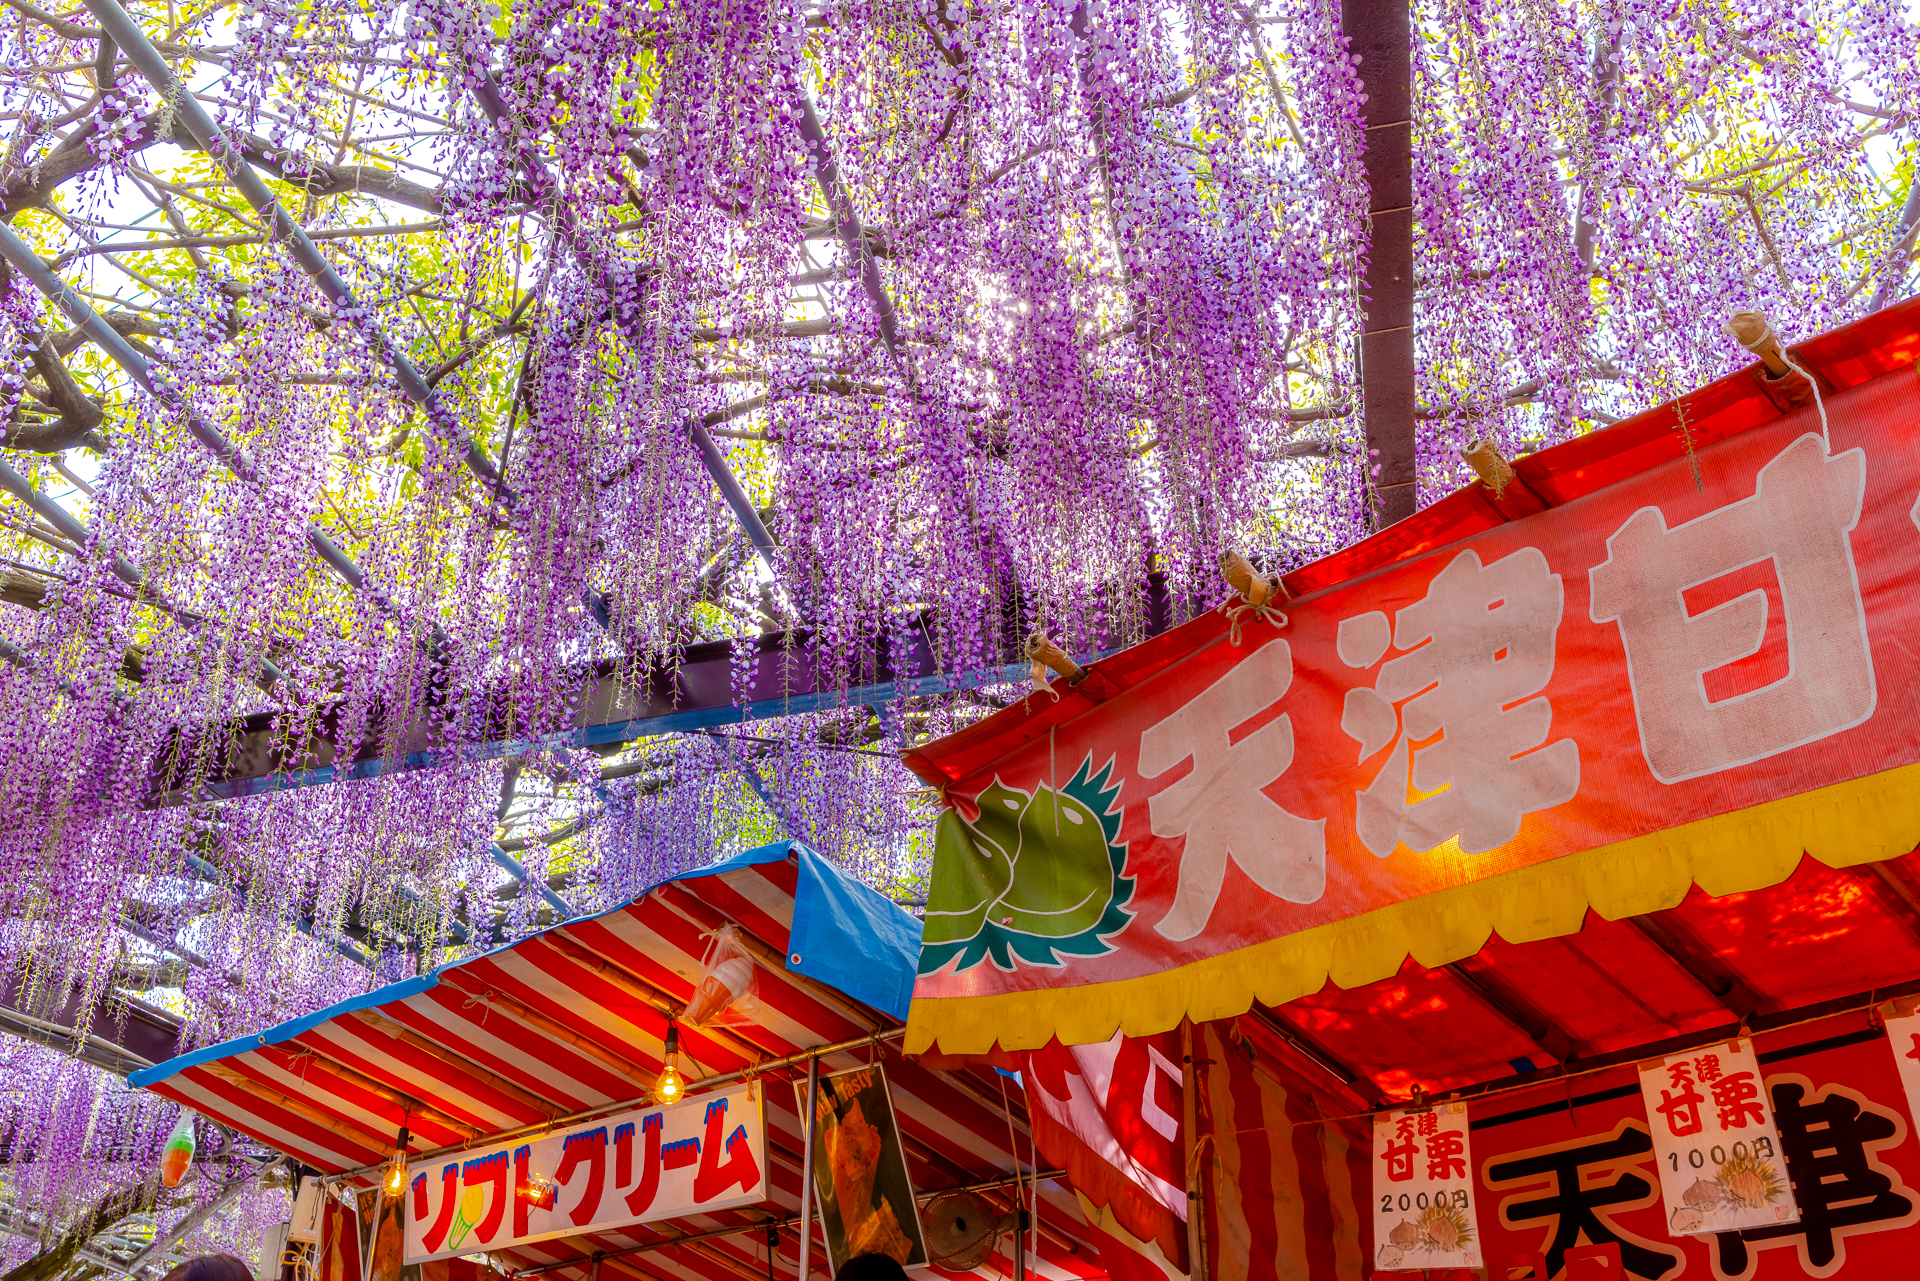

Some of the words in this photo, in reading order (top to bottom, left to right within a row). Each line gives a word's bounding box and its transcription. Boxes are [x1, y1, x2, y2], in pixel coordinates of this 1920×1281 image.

[1137, 431, 1920, 941] 天津甘
[837, 1069, 873, 1101] Tasty
[1667, 1054, 1723, 1089] 天津
[1655, 1071, 1766, 1138] 甘栗
[1395, 1112, 1439, 1140] 天津
[1380, 1130, 1467, 1182] 甘栗
[1668, 1136, 1774, 1172] 1000円
[411, 1096, 761, 1255] ソフトクリーム
[363, 1207, 376, 1225] Ne
[1381, 1189, 1469, 1213] 2000円
